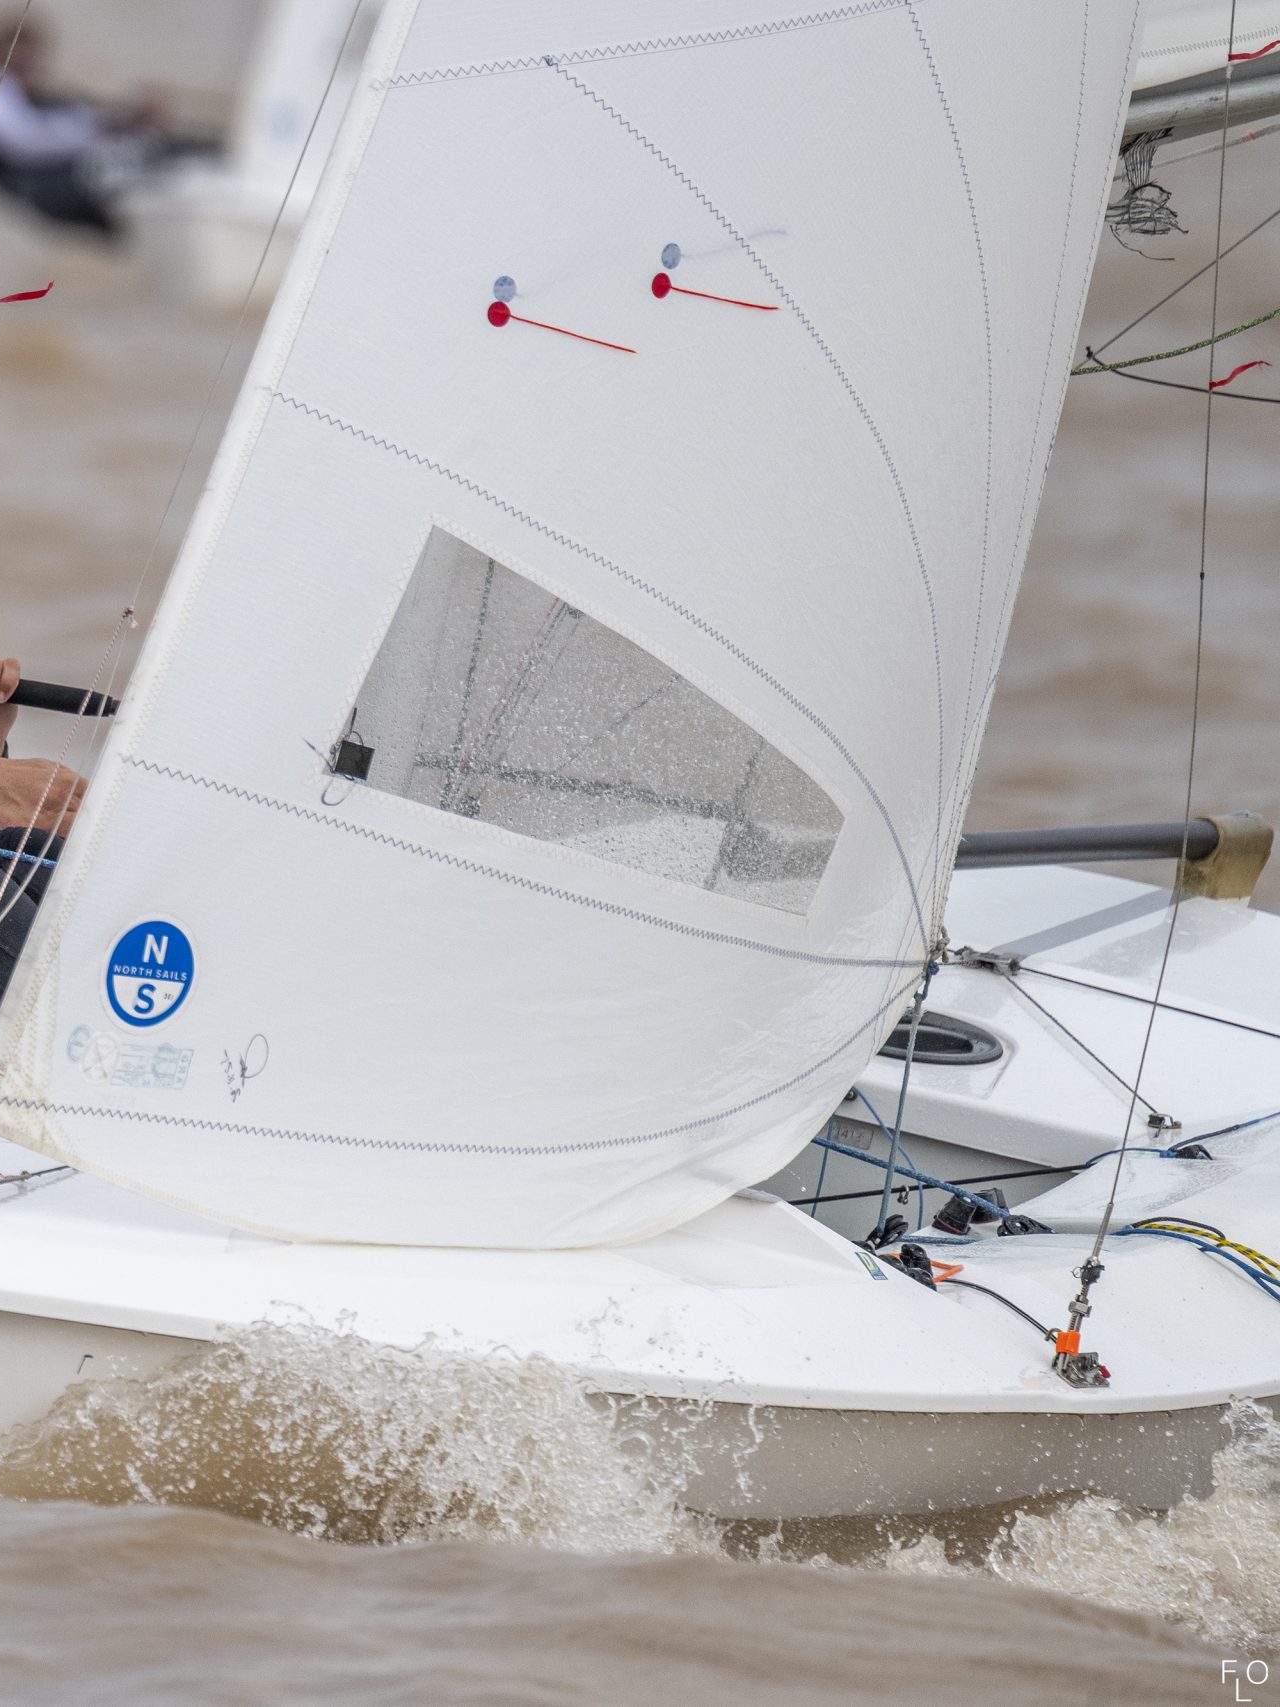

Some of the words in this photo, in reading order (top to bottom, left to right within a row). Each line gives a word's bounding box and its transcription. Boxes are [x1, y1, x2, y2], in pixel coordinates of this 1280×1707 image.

[143, 934, 169, 965] N
[113, 965, 153, 977] NORTH
[155, 969, 187, 981] SAILS
[134, 983, 157, 1014] S
